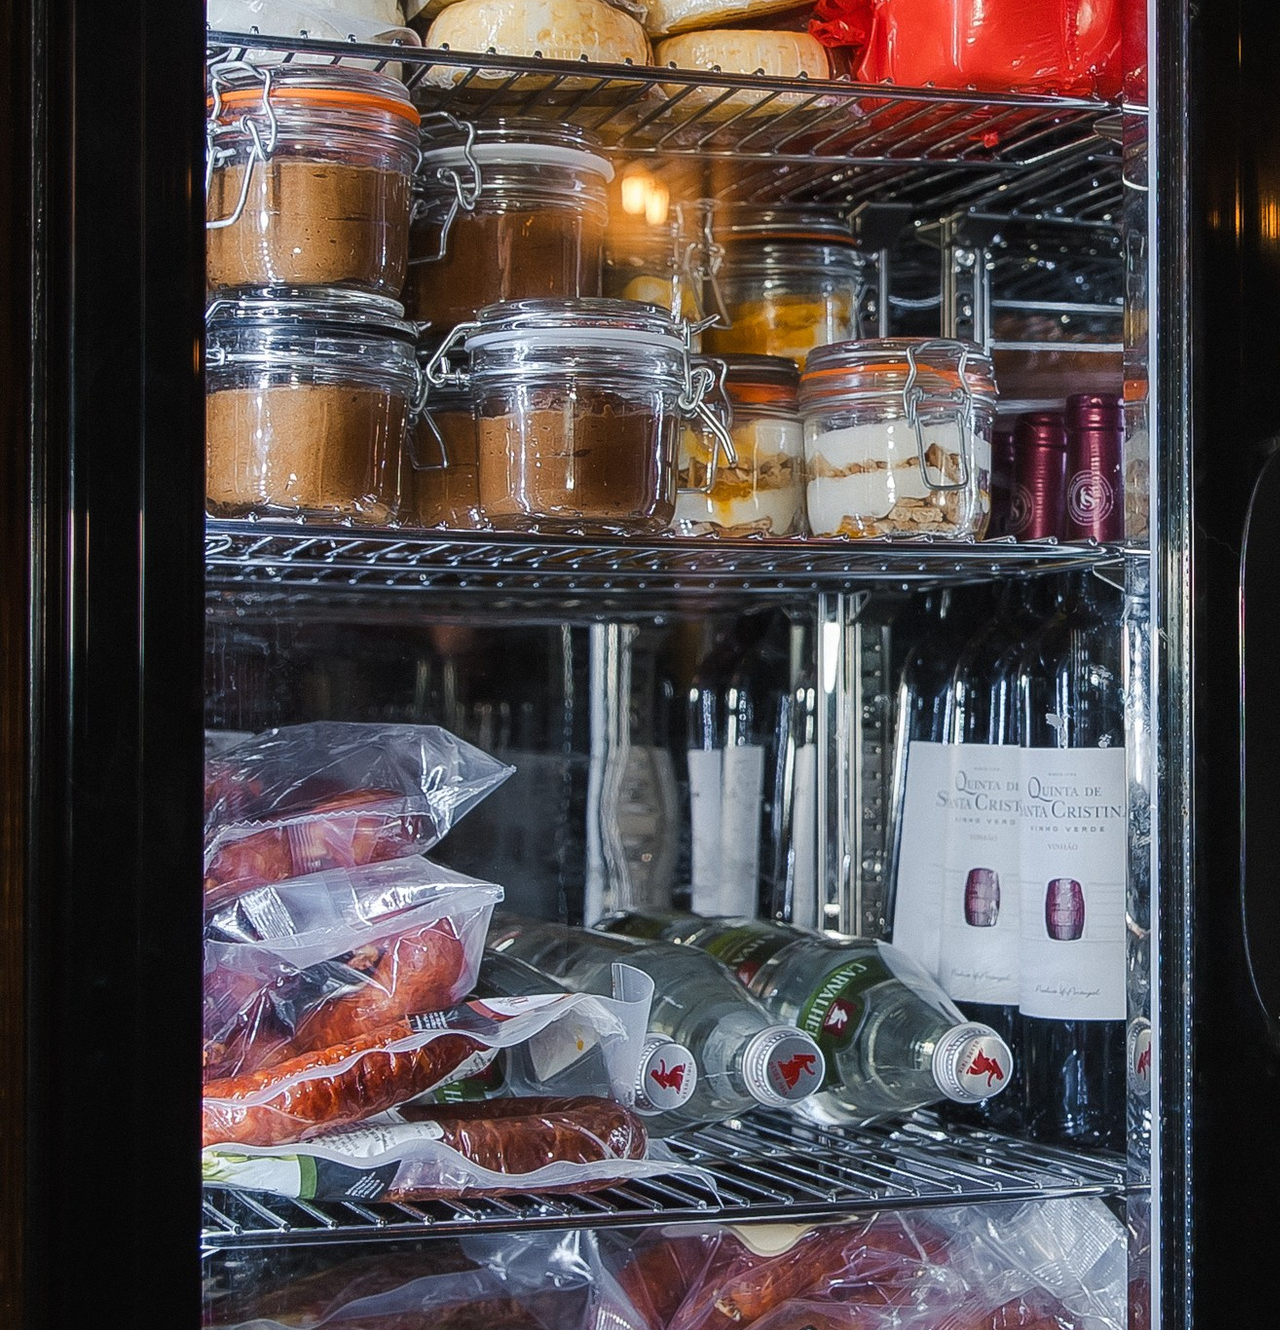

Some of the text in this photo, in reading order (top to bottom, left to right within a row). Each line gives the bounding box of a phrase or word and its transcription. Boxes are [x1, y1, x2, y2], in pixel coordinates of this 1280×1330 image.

[955, 771, 1002, 796] QUINTA
[1028, 776, 1102, 803] QUINTA DE
[1066, 825, 1106, 833] VERDE
